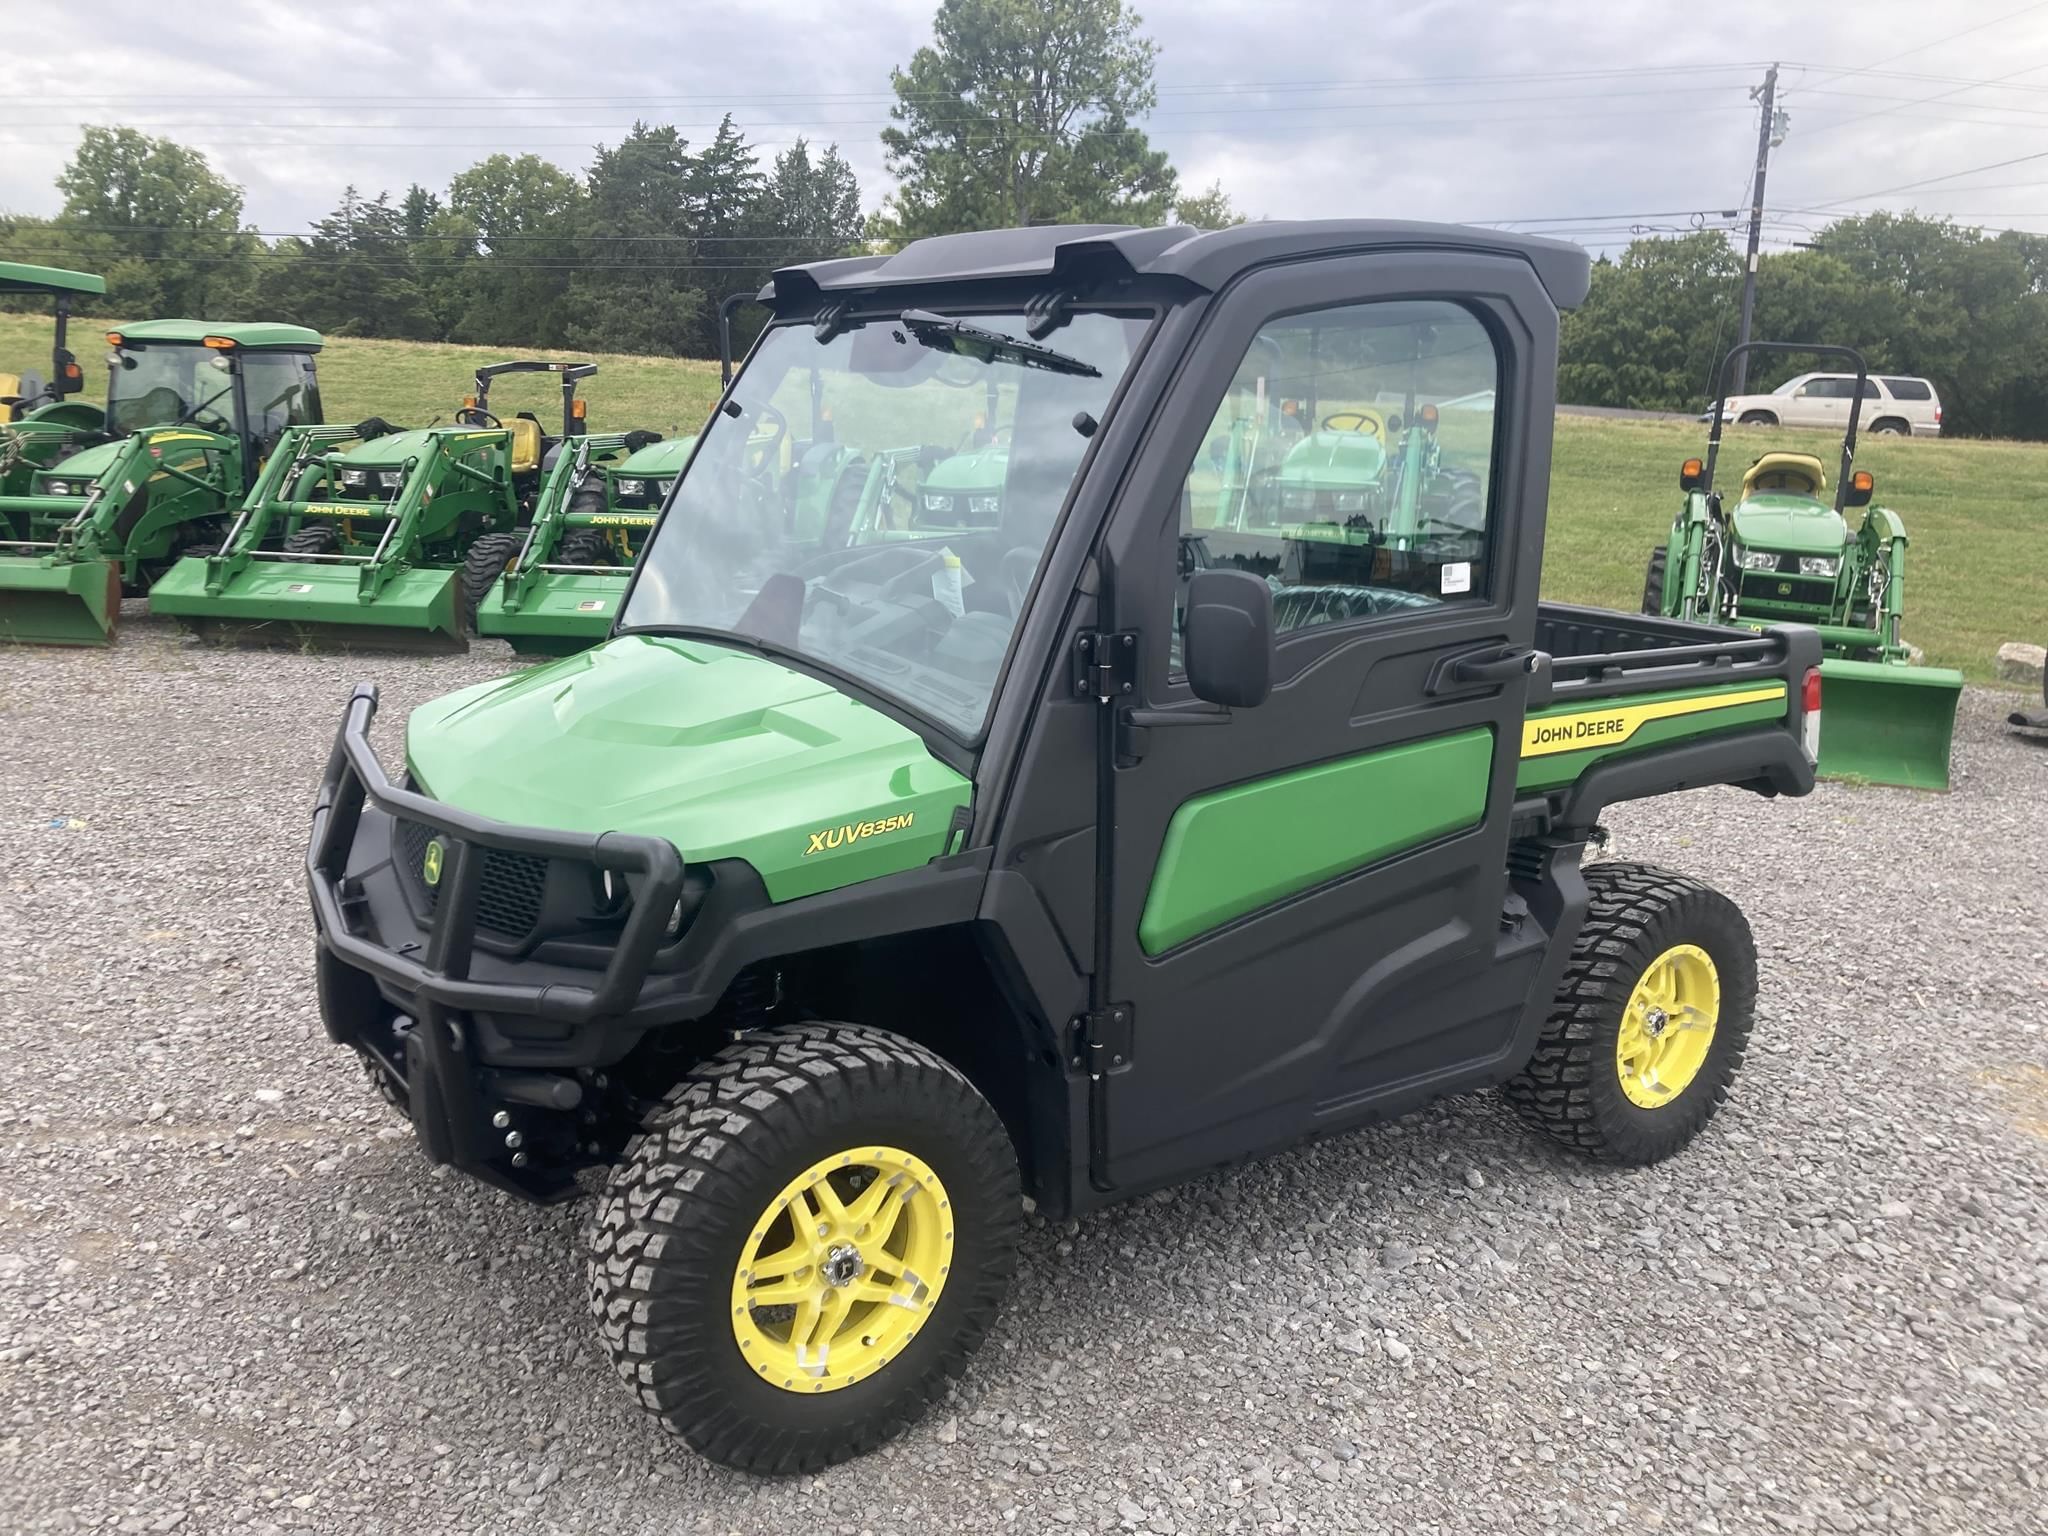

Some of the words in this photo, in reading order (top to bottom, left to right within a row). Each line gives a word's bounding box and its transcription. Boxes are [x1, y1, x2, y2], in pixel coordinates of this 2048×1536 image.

[304, 505, 333, 514] JOHN
[335, 506, 370, 516] DEERE
[590, 516, 619, 525] JOHN
[1532, 725, 1572, 744] JOHN
[1576, 719, 1624, 738] DEERE
[804, 811, 914, 855] XUV835M
